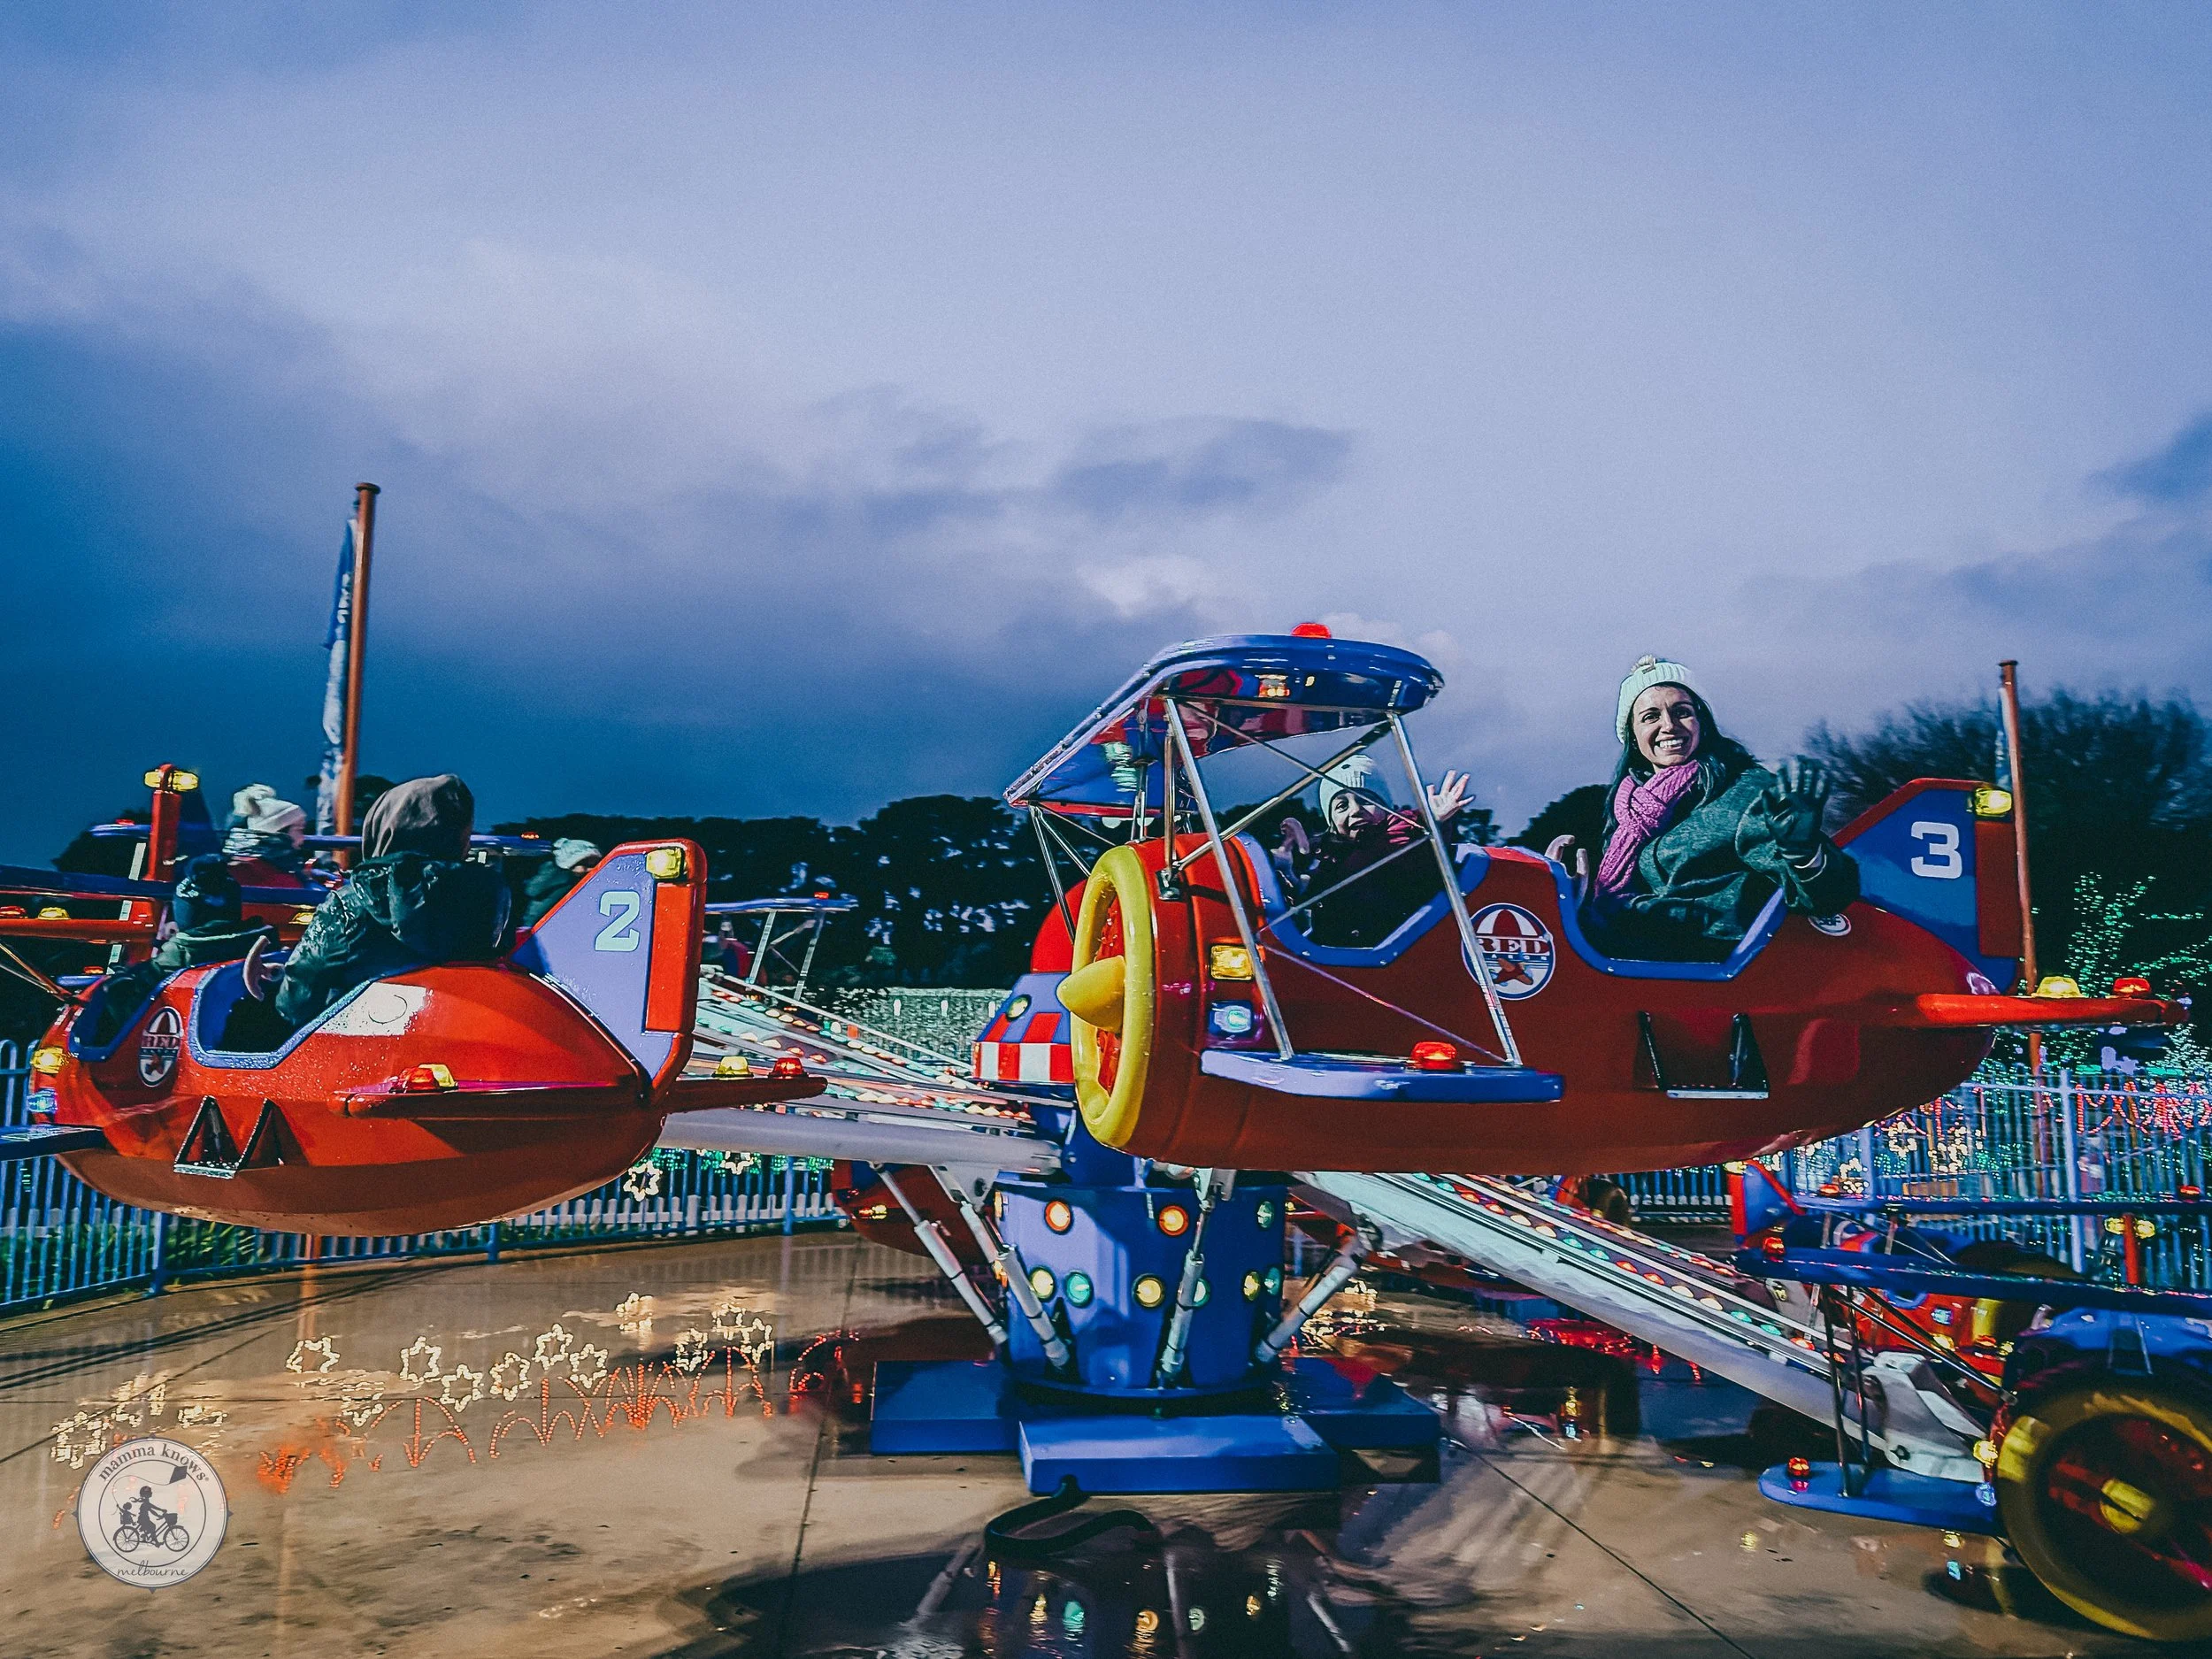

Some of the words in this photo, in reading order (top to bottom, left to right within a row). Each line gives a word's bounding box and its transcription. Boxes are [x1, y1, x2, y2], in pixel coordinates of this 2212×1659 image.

[1911, 821, 1962, 879] 3
[595, 891, 640, 951] 2
[1479, 938, 1550, 953] RED
